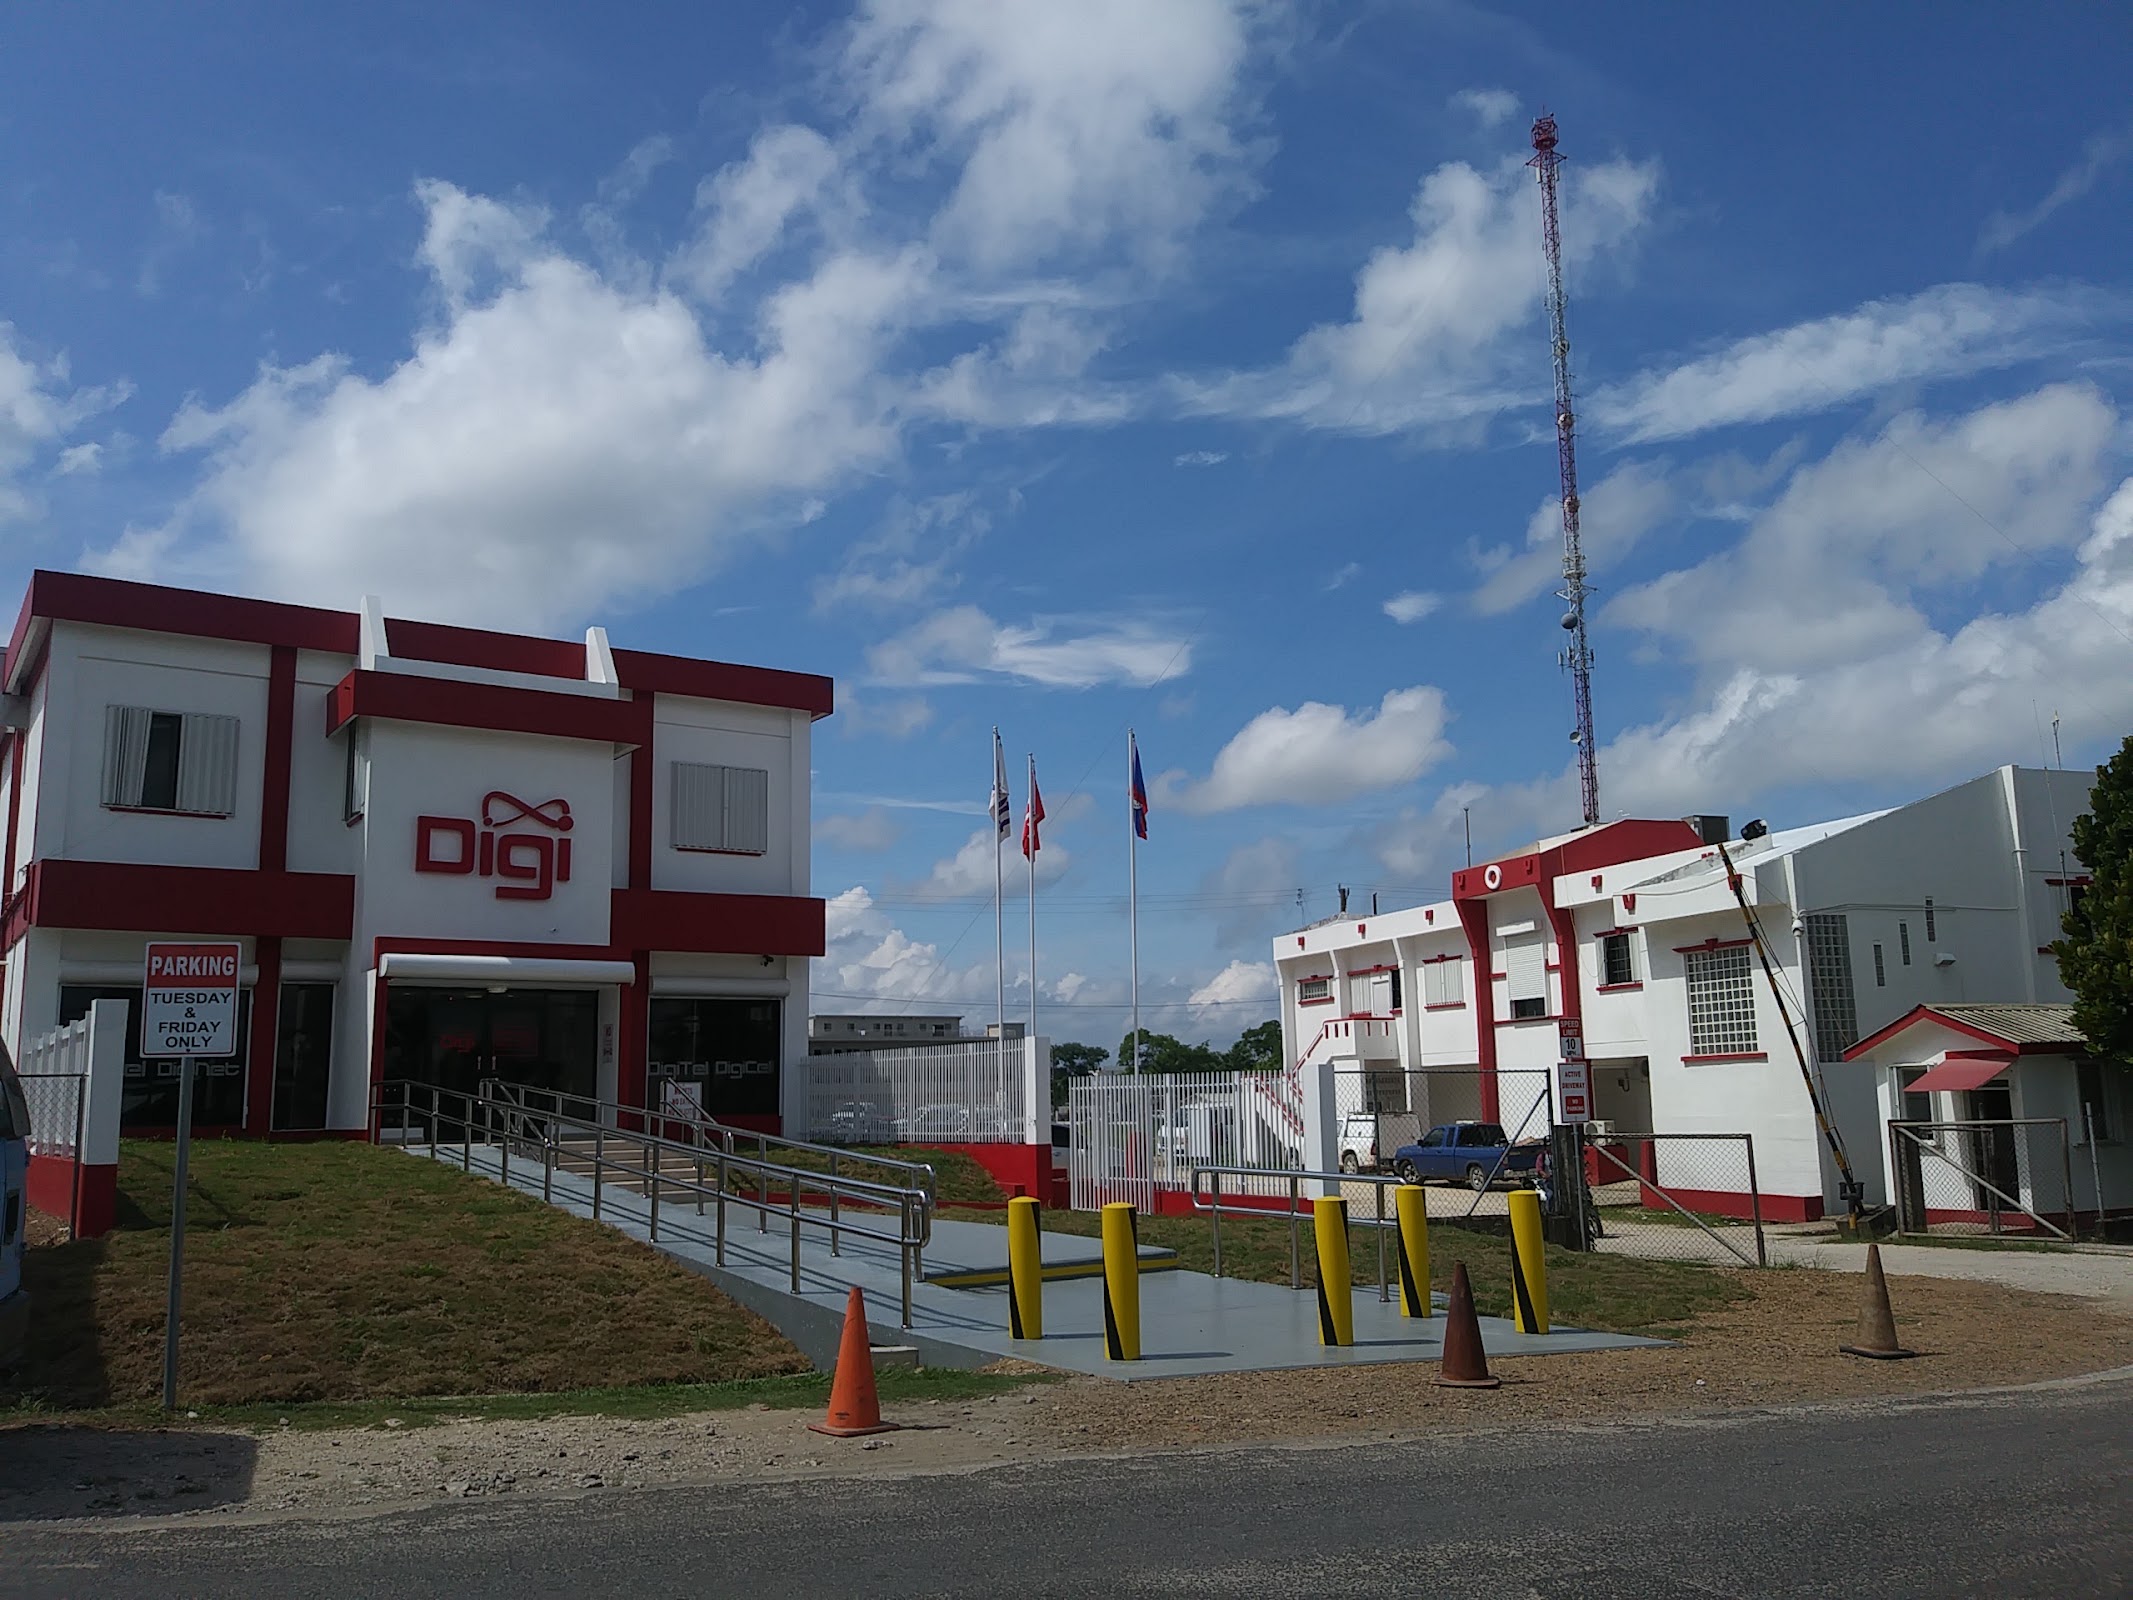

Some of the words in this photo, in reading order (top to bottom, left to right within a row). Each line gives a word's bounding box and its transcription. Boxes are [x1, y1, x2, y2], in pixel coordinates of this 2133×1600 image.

[416, 791, 574, 900] Digi
[151, 956, 235, 976] PARKING
[151, 992, 232, 1004] TUESDAY
[184, 1007, 196, 1018] &
[158, 1021, 221, 1033] FRIDAY
[1560, 1020, 1579, 1028] SPEED
[165, 1036, 212, 1048] ONLY
[1565, 1038, 1576, 1050] 10
[157, 1061, 240, 1080] DiNet
